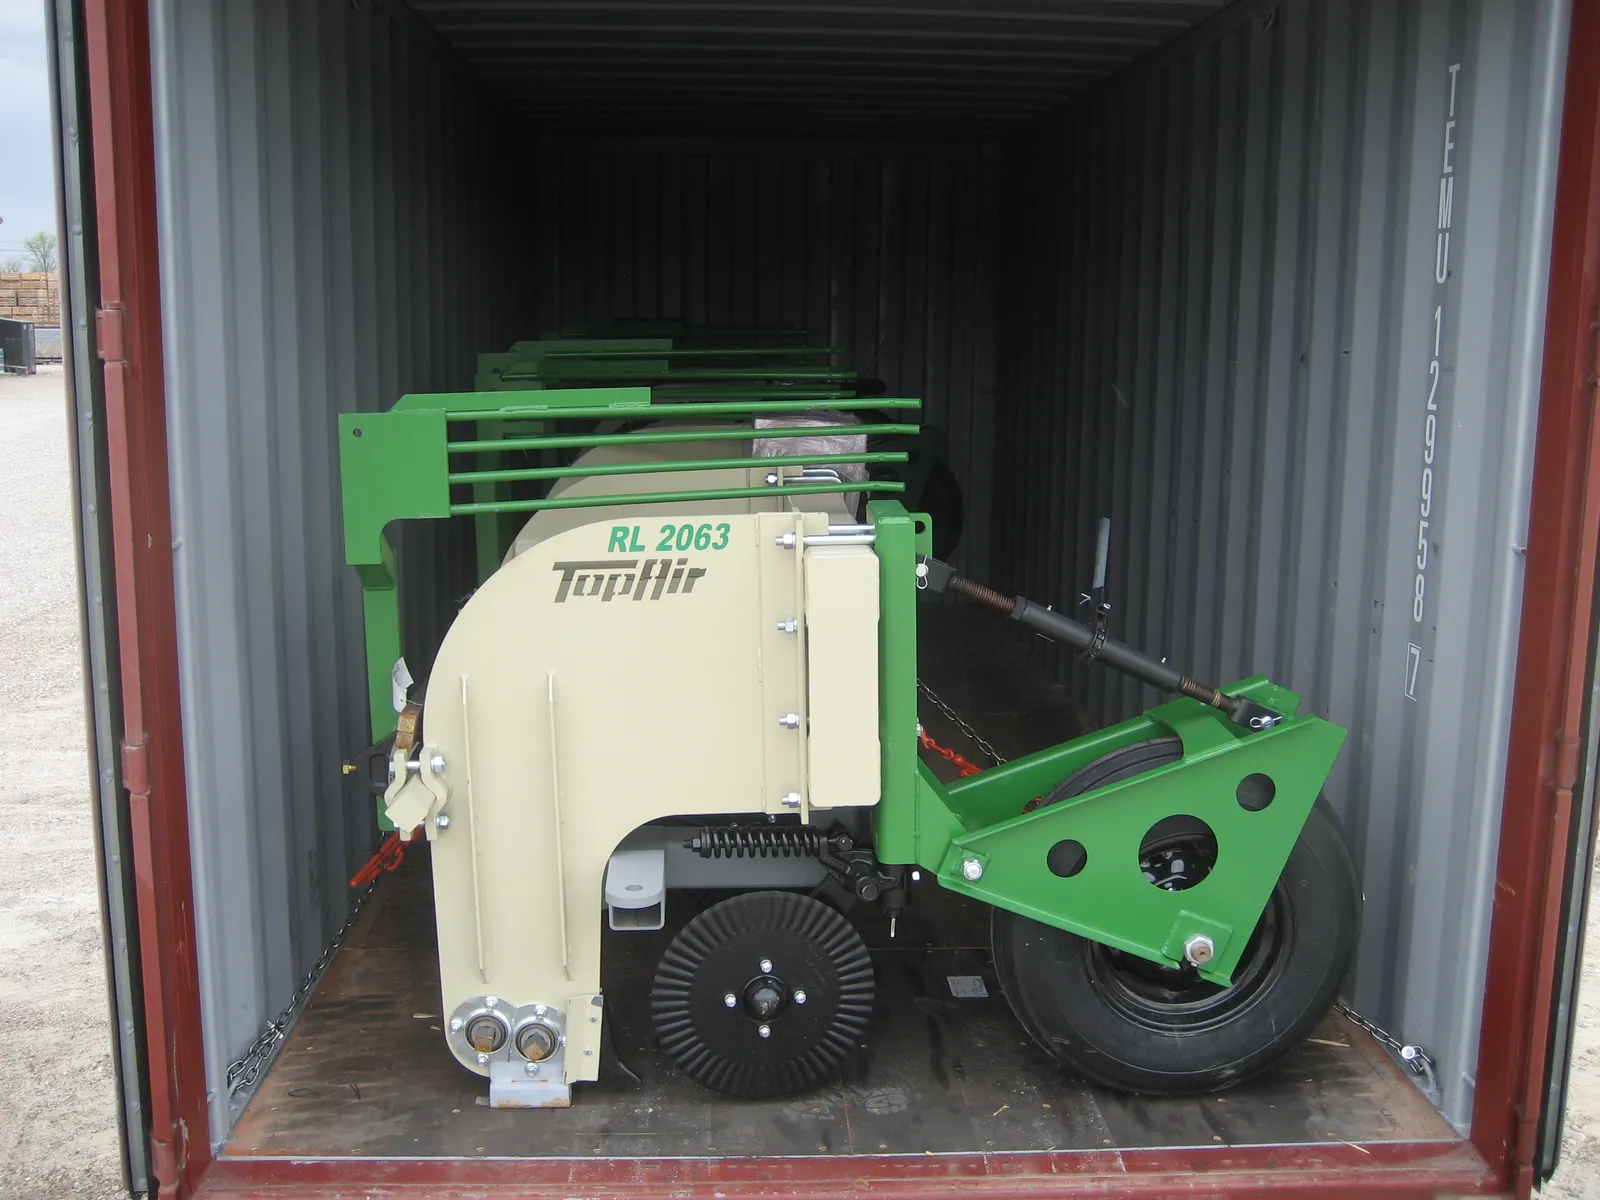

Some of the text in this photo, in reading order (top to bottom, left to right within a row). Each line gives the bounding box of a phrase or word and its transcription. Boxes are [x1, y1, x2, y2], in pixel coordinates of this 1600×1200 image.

[607, 522, 731, 552] RL 2063
[1409, 63, 1461, 697] TEMU 129958 7
